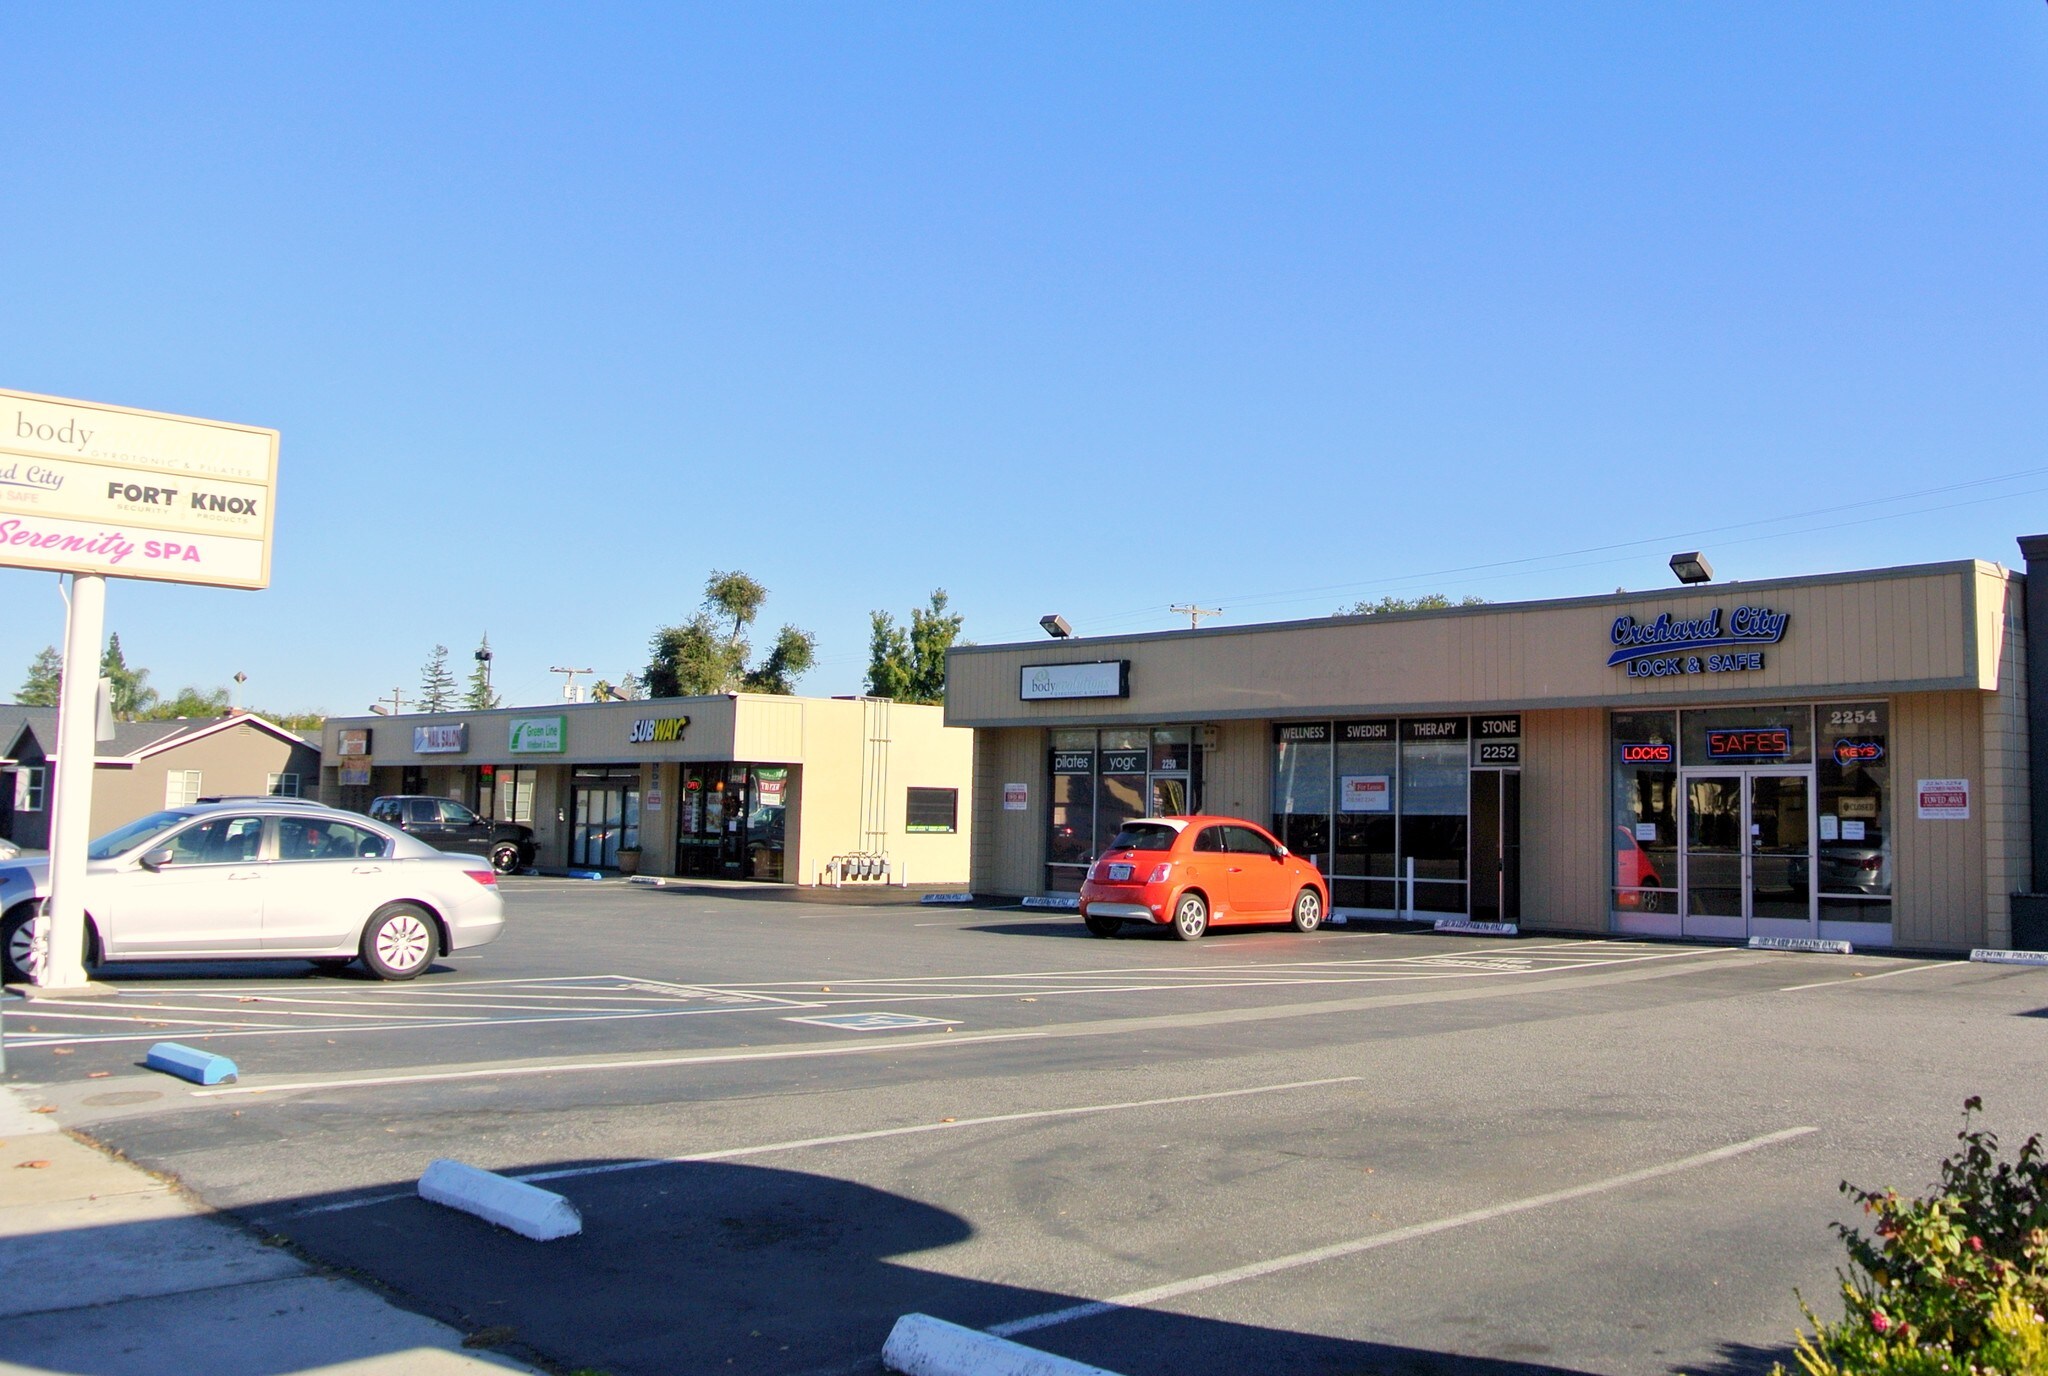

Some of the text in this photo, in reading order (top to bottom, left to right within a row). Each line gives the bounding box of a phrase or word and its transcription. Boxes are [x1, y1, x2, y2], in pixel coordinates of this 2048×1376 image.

[15, 411, 95, 452] body
[26, 465, 65, 491] City
[200, 464, 252, 477] PILATES
[6, 490, 40, 503] SAFE
[108, 481, 257, 516] FORT KNOX
[117, 503, 249, 524] SECURITY PRODUCTS
[143, 540, 201, 563] SPA
[1609, 605, 1788, 646] Orchard City
[1626, 652, 1761, 678] LOCK & SAFE
[1031, 678, 1056, 696] body
[1830, 710, 1878, 725] 2254
[526, 724, 558, 737] Green Line
[629, 716, 687, 743] SUBWAY
[1281, 726, 1325, 739] WELLNESS
[1346, 724, 1387, 738] SWEDISH
[1413, 722, 1457, 736] THERAPY
[1482, 719, 1517, 734] STONE
[441, 729, 462, 748] SALON
[1710, 733, 1786, 754] SAFES
[1482, 746, 1516, 759] 2252
[1623, 747, 1669, 760] LOCKS
[1839, 746, 1876, 758] KEYS
[1055, 754, 1089, 771] pilates
[1161, 759, 1177, 770] 2250
[1850, 803, 1874, 811] CLOSED
[1923, 795, 1963, 804] TOWED AWAY
[1974, 950, 2048, 961] GEMINI PARKING
